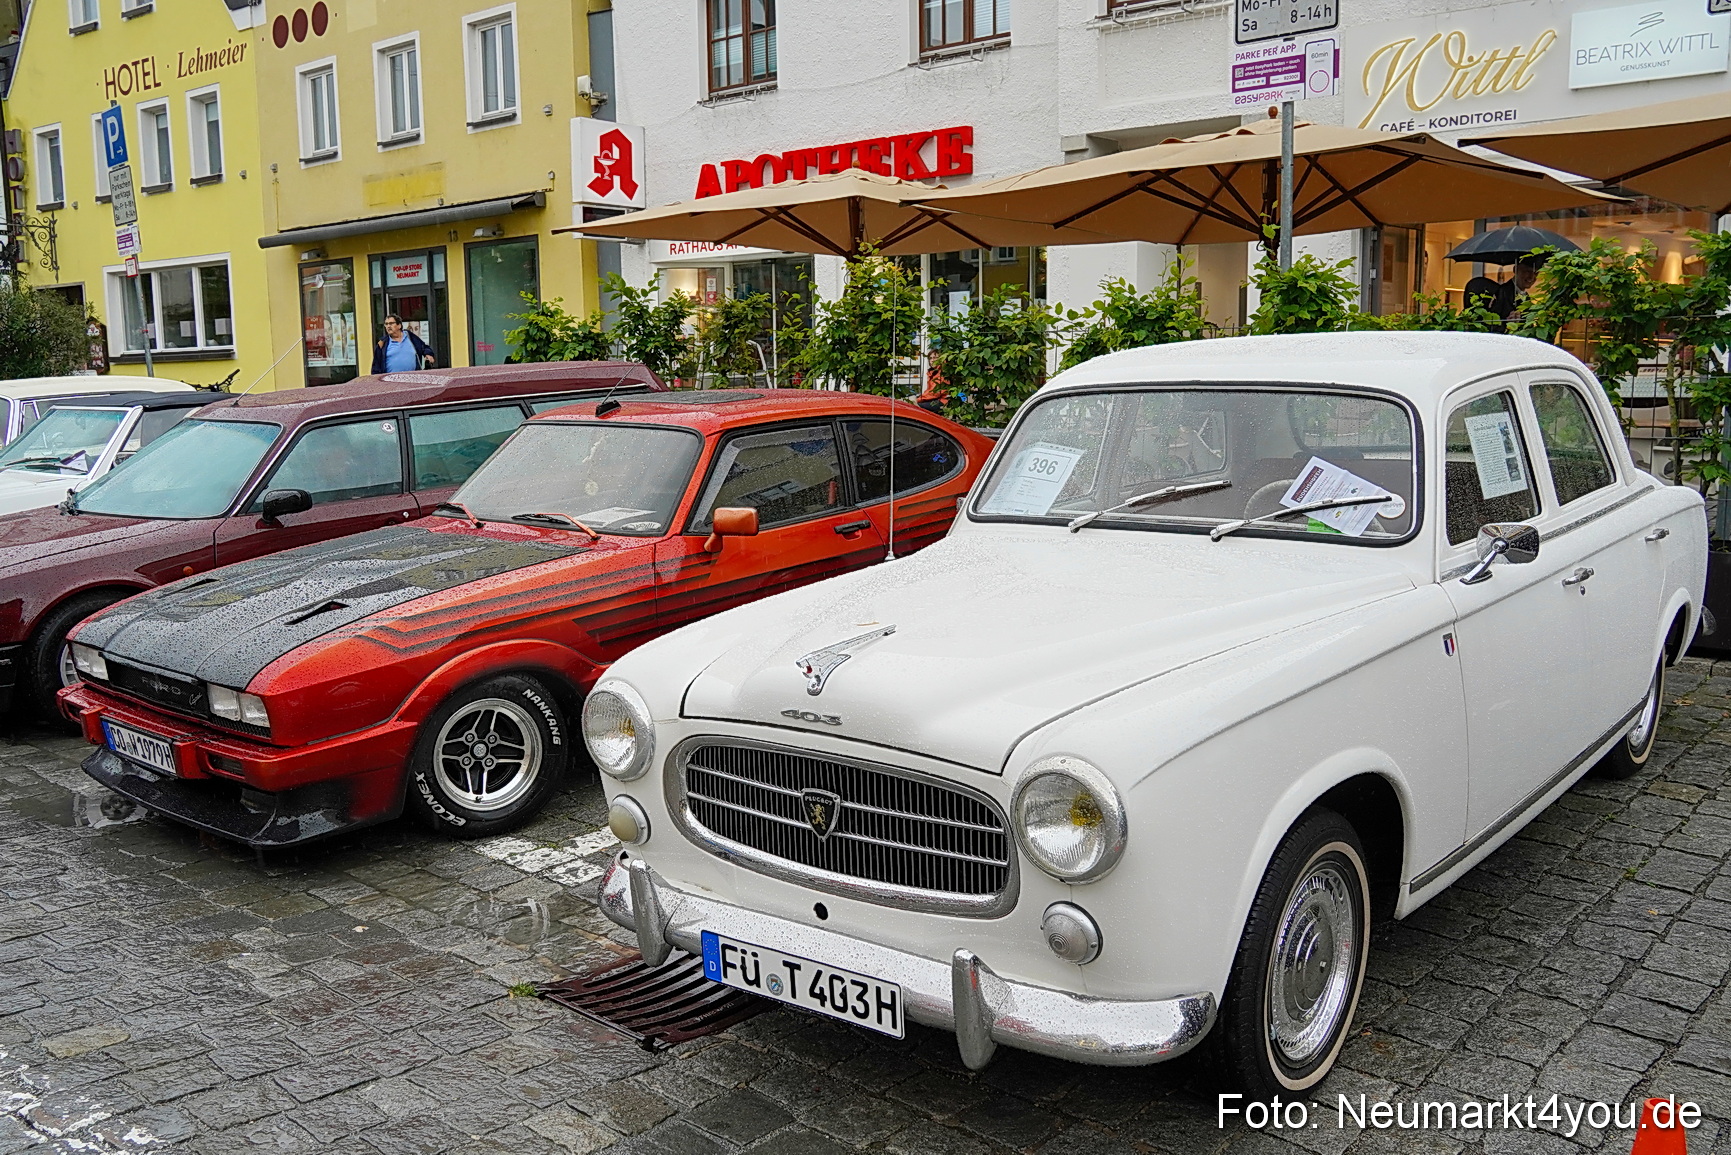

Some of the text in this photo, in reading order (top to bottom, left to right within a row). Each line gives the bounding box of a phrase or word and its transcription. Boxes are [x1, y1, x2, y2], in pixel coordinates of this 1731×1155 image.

[1242, 18, 1257, 32] Sa
[1235, 43, 1297, 61] PARKE PER APP
[1576, 32, 1720, 66] BEATRIX WITTL
[104, 38, 247, 100] HOTEL Lehmeier
[1620, 60, 1671, 72] GENUSSKUNST
[1358, 29, 1557, 129] Wittl
[1380, 118, 1415, 132] CAFÉ
[1428, 109, 1518, 129] KONDITOREI
[106, 115, 120, 160] P
[695, 126, 974, 200] APOTHEKE
[669, 241, 723, 255] RATHAUS
[393, 263, 422, 273] POP-UP STORE
[396, 271, 420, 279] NEUMARKT
[1028, 457, 1059, 475] 396
[522, 688, 561, 746] NANKANG
[781, 709, 843, 726] 403
[136, 736, 175, 770] 1979H
[414, 770, 467, 827] ECONEX
[709, 960, 717, 972] D
[720, 943, 898, 1030] FÜ T 403H
